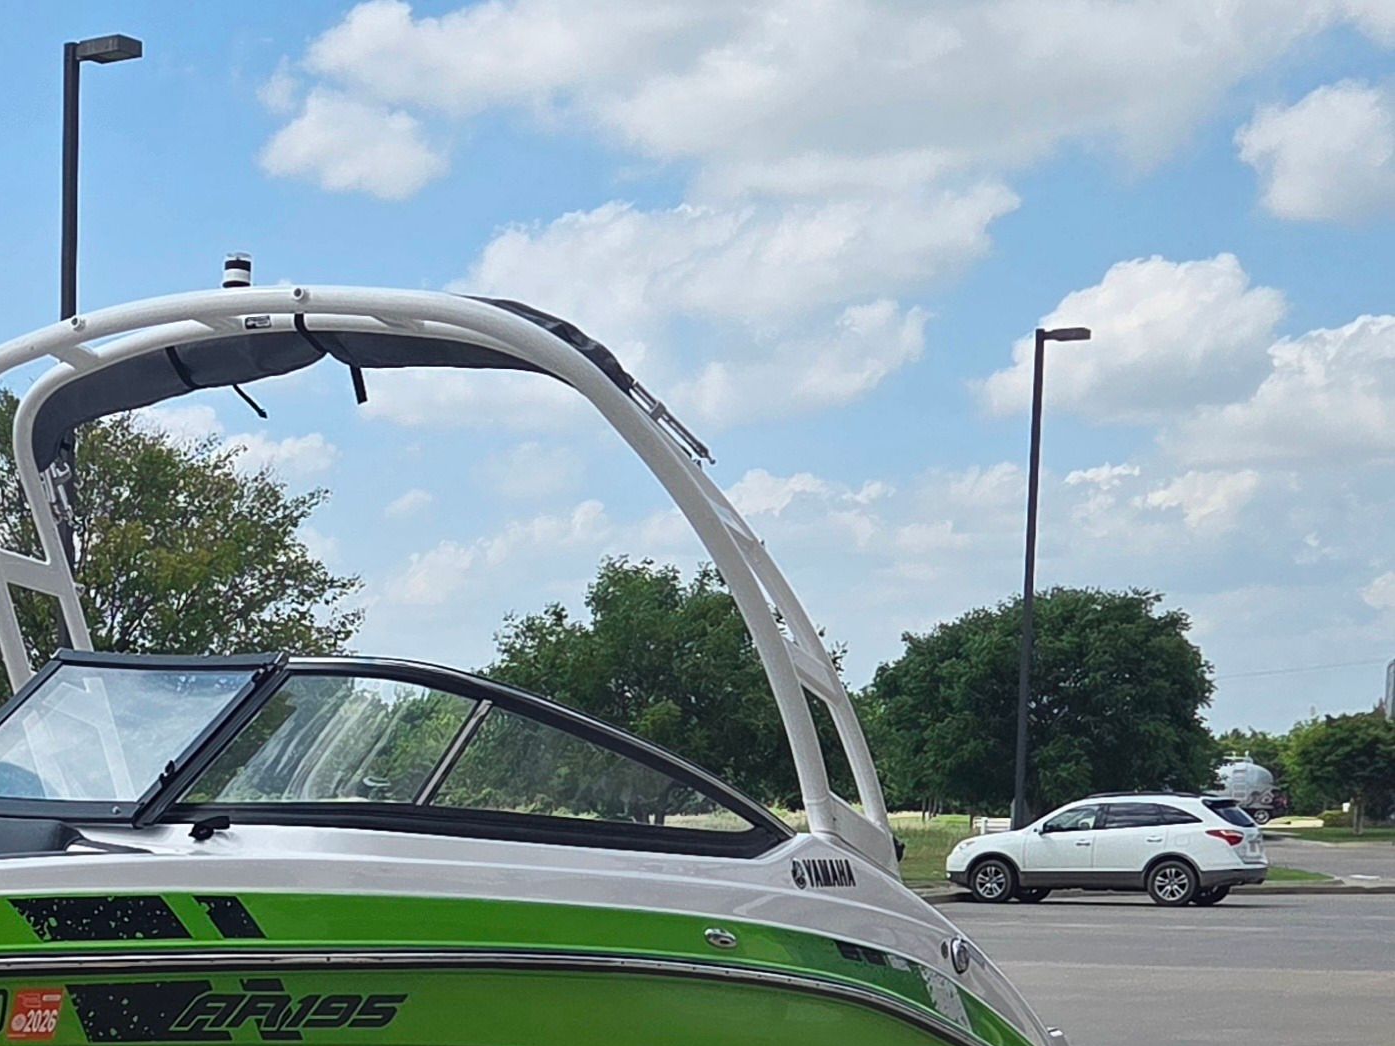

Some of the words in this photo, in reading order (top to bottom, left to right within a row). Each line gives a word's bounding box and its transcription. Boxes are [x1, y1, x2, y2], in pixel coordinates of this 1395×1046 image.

[802, 859, 856, 888] YAMAHA
[23, 1009, 58, 1033] 2026
[170, 993, 408, 1031] AR195
